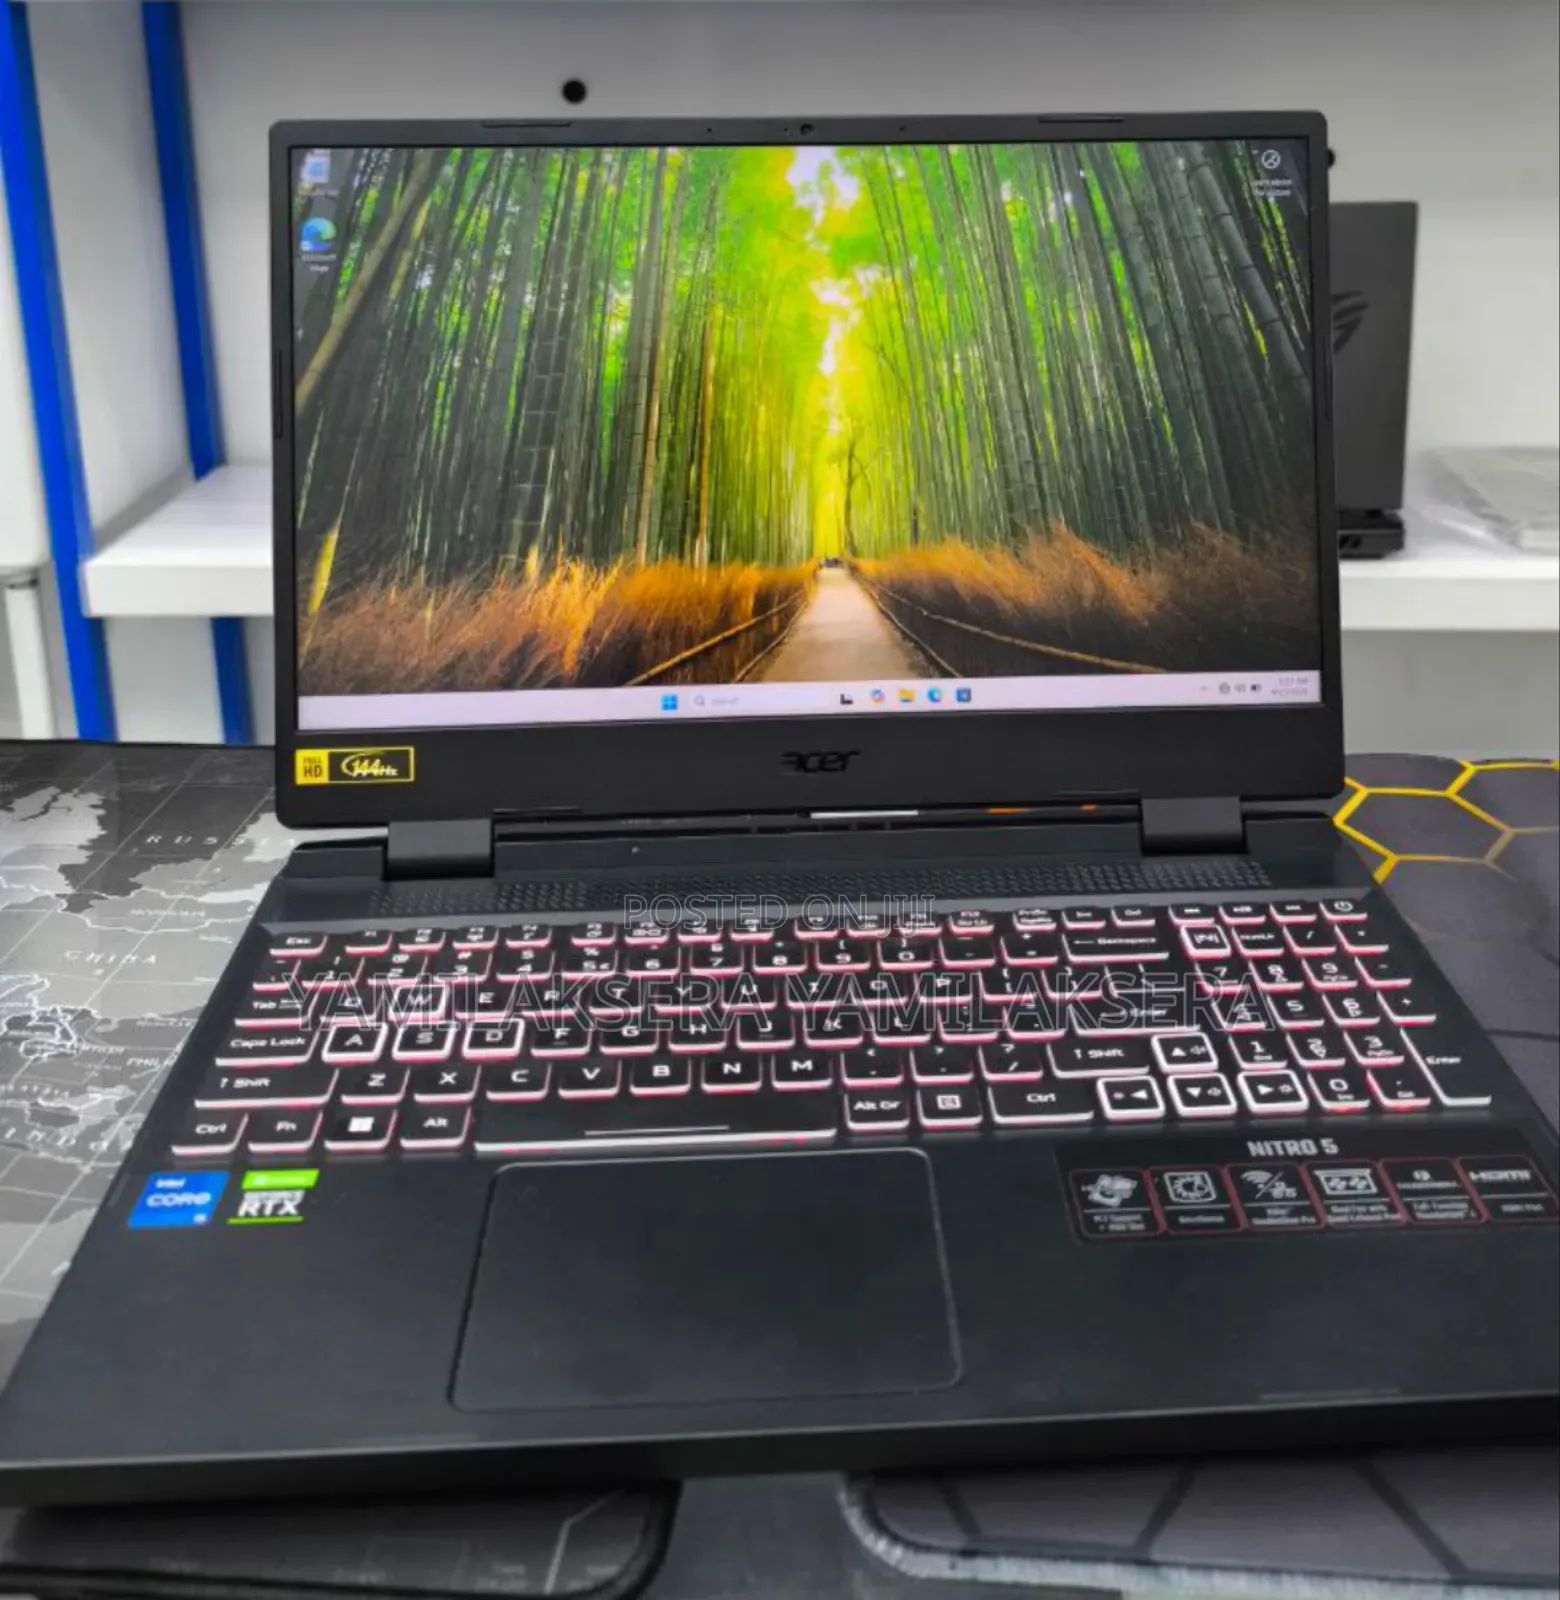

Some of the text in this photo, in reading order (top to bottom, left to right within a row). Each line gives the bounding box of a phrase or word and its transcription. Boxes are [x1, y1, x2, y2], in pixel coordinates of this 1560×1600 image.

[780, 750, 860, 773] acer
[303, 765, 323, 778] HD
[64, 950, 157, 965] CHINA
[772, 955, 788, 966] 8
[835, 954, 852, 964] 9
[644, 959, 661, 969] 6
[1322, 962, 1339, 974] 9
[543, 990, 560, 1001] R
[612, 988, 628, 999] T
[676, 986, 692, 996] Y
[741, 984, 758, 996] U
[479, 991, 495, 1003] E
[252, 1000, 277, 1010] Tab
[1286, 1000, 1304, 1012] 5
[621, 1026, 639, 1038] G
[689, 1024, 707, 1036] H
[759, 1020, 773, 1033] J
[416, 1032, 434, 1044] S
[485, 1031, 503, 1042] D
[555, 1028, 571, 1039] F
[270, 1036, 305, 1047] Lock
[345, 1034, 363, 1046] A
[1087, 1048, 1126, 1059] Shift
[652, 1065, 671, 1077] B
[723, 1062, 742, 1075] N
[791, 1059, 813, 1072] M
[439, 1072, 458, 1084] X
[511, 1069, 530, 1082] C
[582, 1067, 600, 1080] V
[233, 1077, 271, 1088] Shift
[367, 1074, 386, 1087] Z
[1026, 1092, 1056, 1103] Ctrl
[854, 1100, 901, 1110] Alt Gr
[195, 1123, 227, 1134] Ctrl
[275, 1121, 297, 1131] Fn
[423, 1118, 449, 1128] Alt
[1247, 1138, 1339, 1157] NITRO 5
[238, 1199, 300, 1217] RTX
